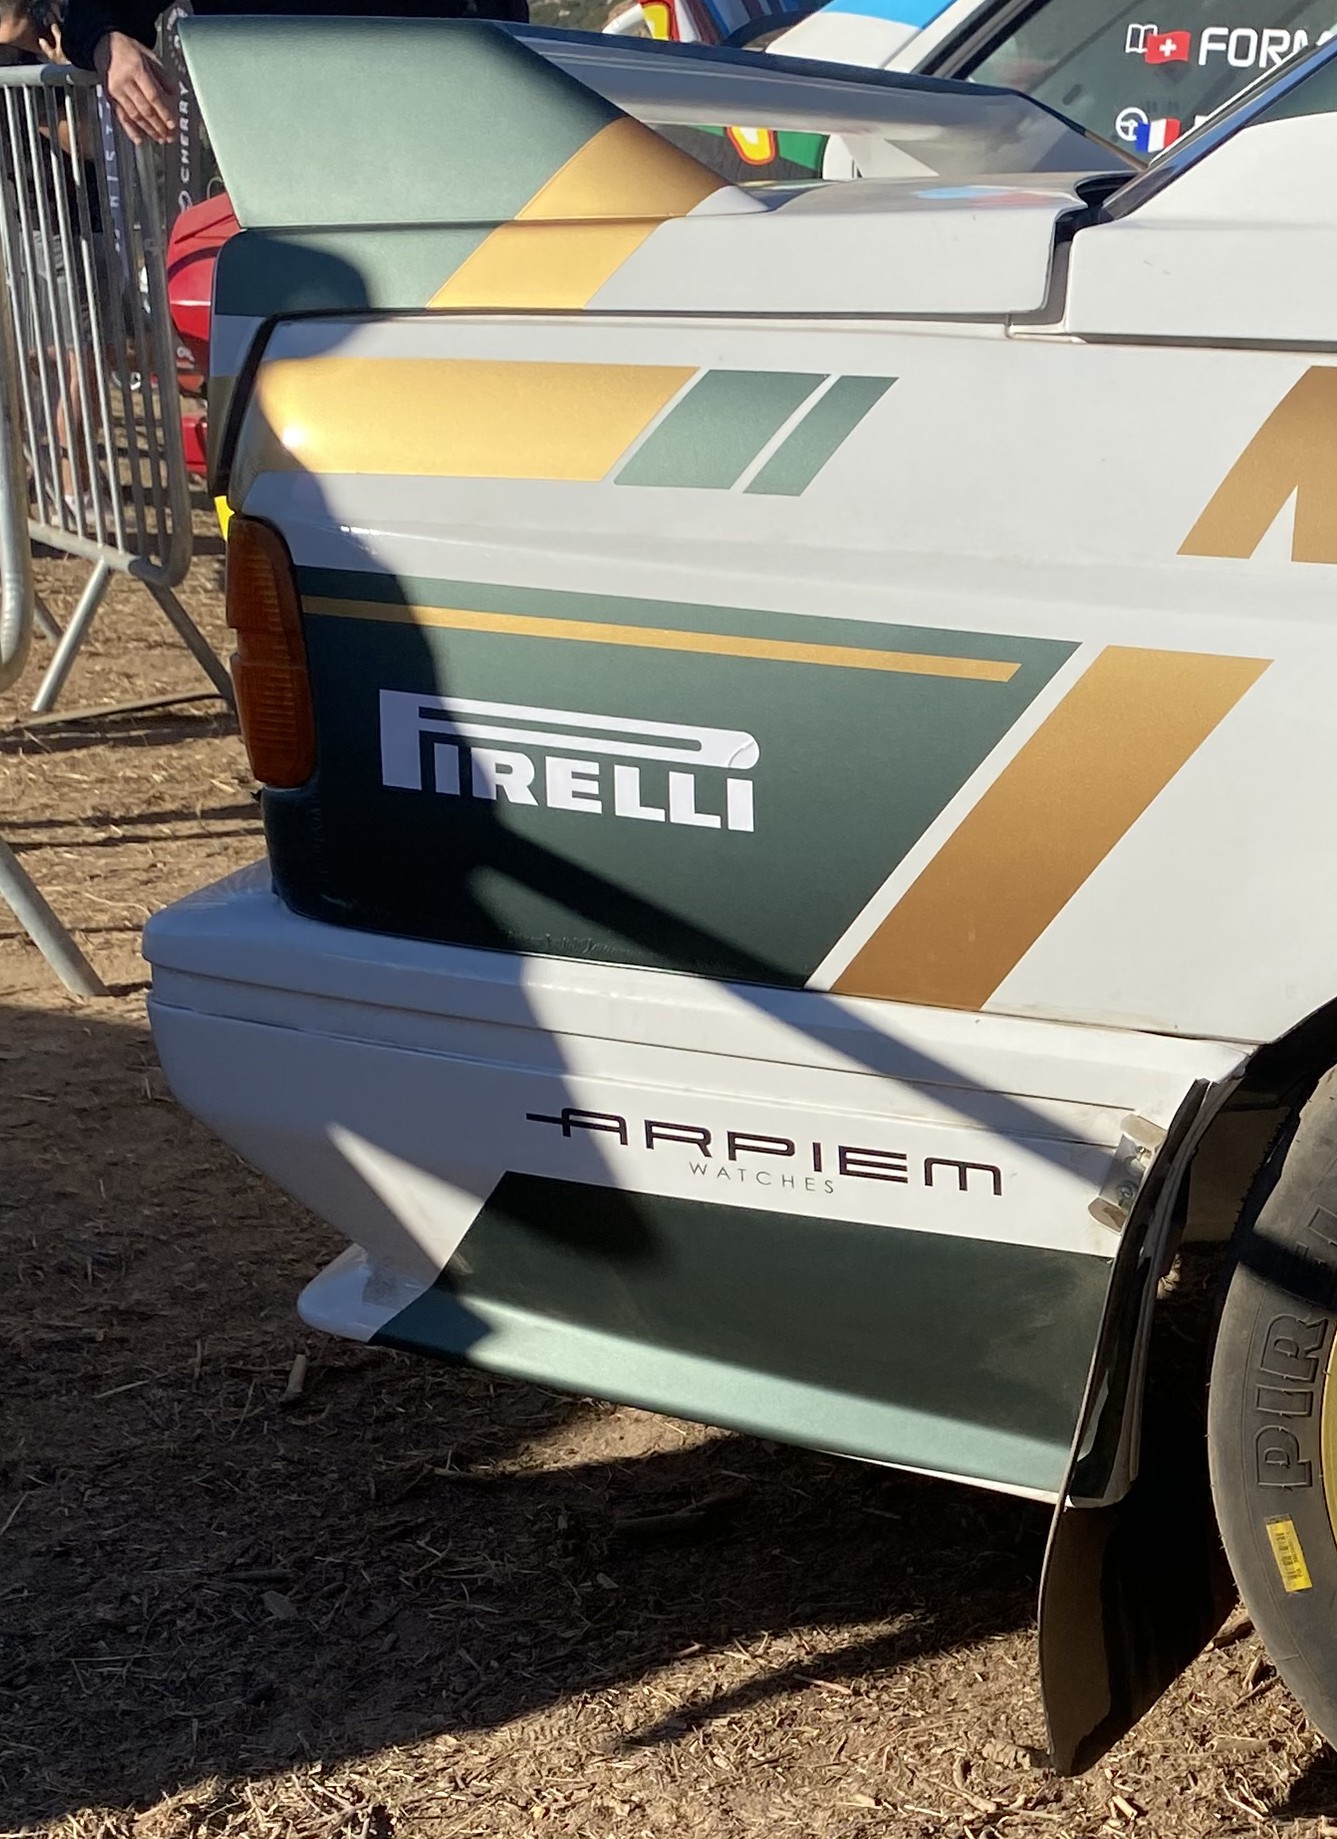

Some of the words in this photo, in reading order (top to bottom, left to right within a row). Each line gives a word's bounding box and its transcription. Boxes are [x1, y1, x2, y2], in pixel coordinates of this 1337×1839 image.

[178, 80, 191, 183] CHERRY
[379, 688, 760, 832] PIRELLI
[525, 1107, 1002, 1196] ARPIEM
[688, 1161, 834, 1194] WATCHES
